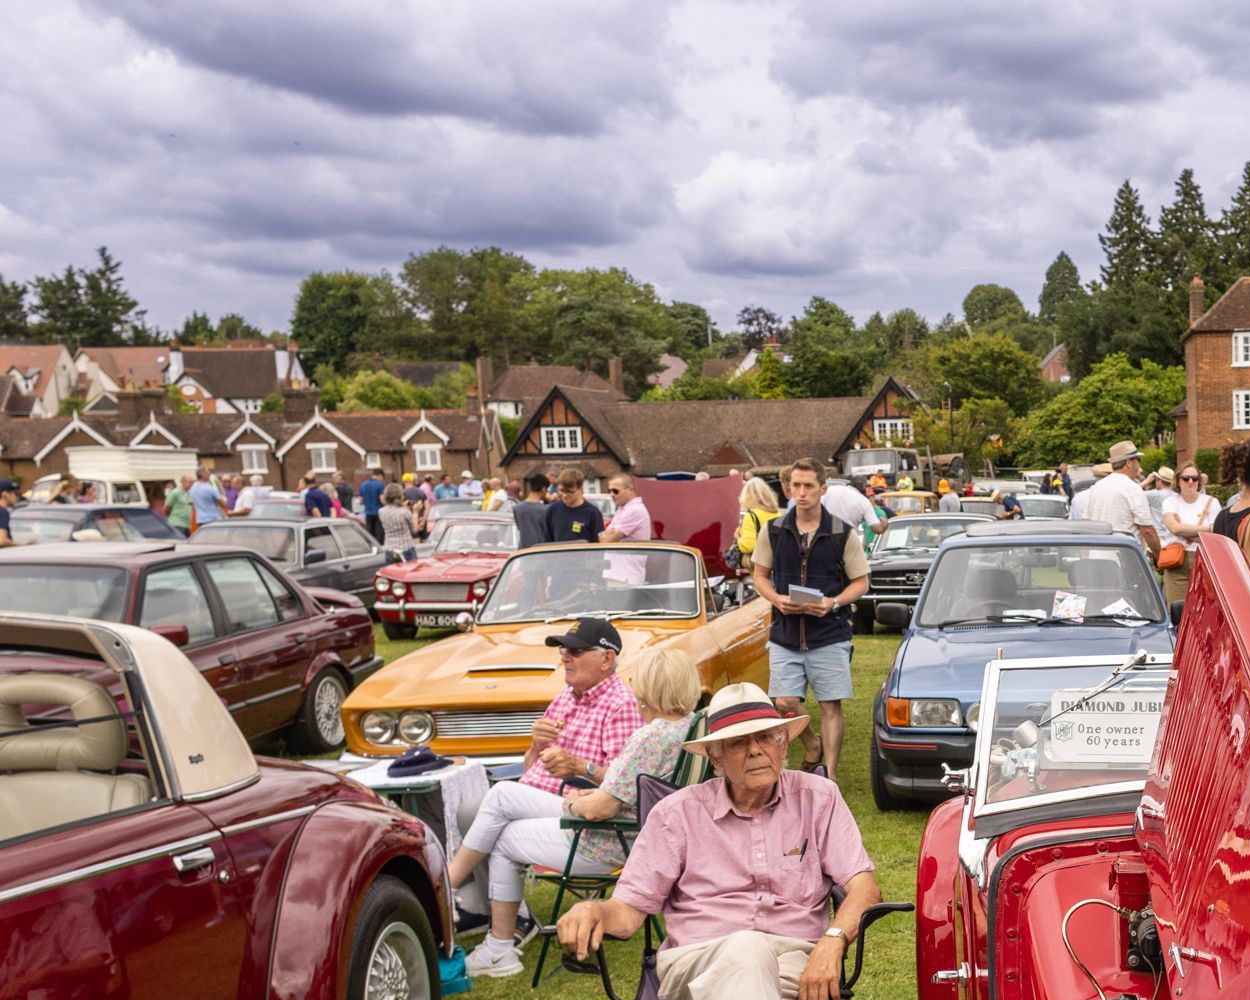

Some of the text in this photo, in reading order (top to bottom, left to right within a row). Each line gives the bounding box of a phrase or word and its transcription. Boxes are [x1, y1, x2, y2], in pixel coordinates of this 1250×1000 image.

[415, 615, 436, 626] HAD
[1060, 700, 1126, 712] DIAMOND
[1077, 723, 1145, 734] One owner
[1086, 736, 1141, 748] 60 years
